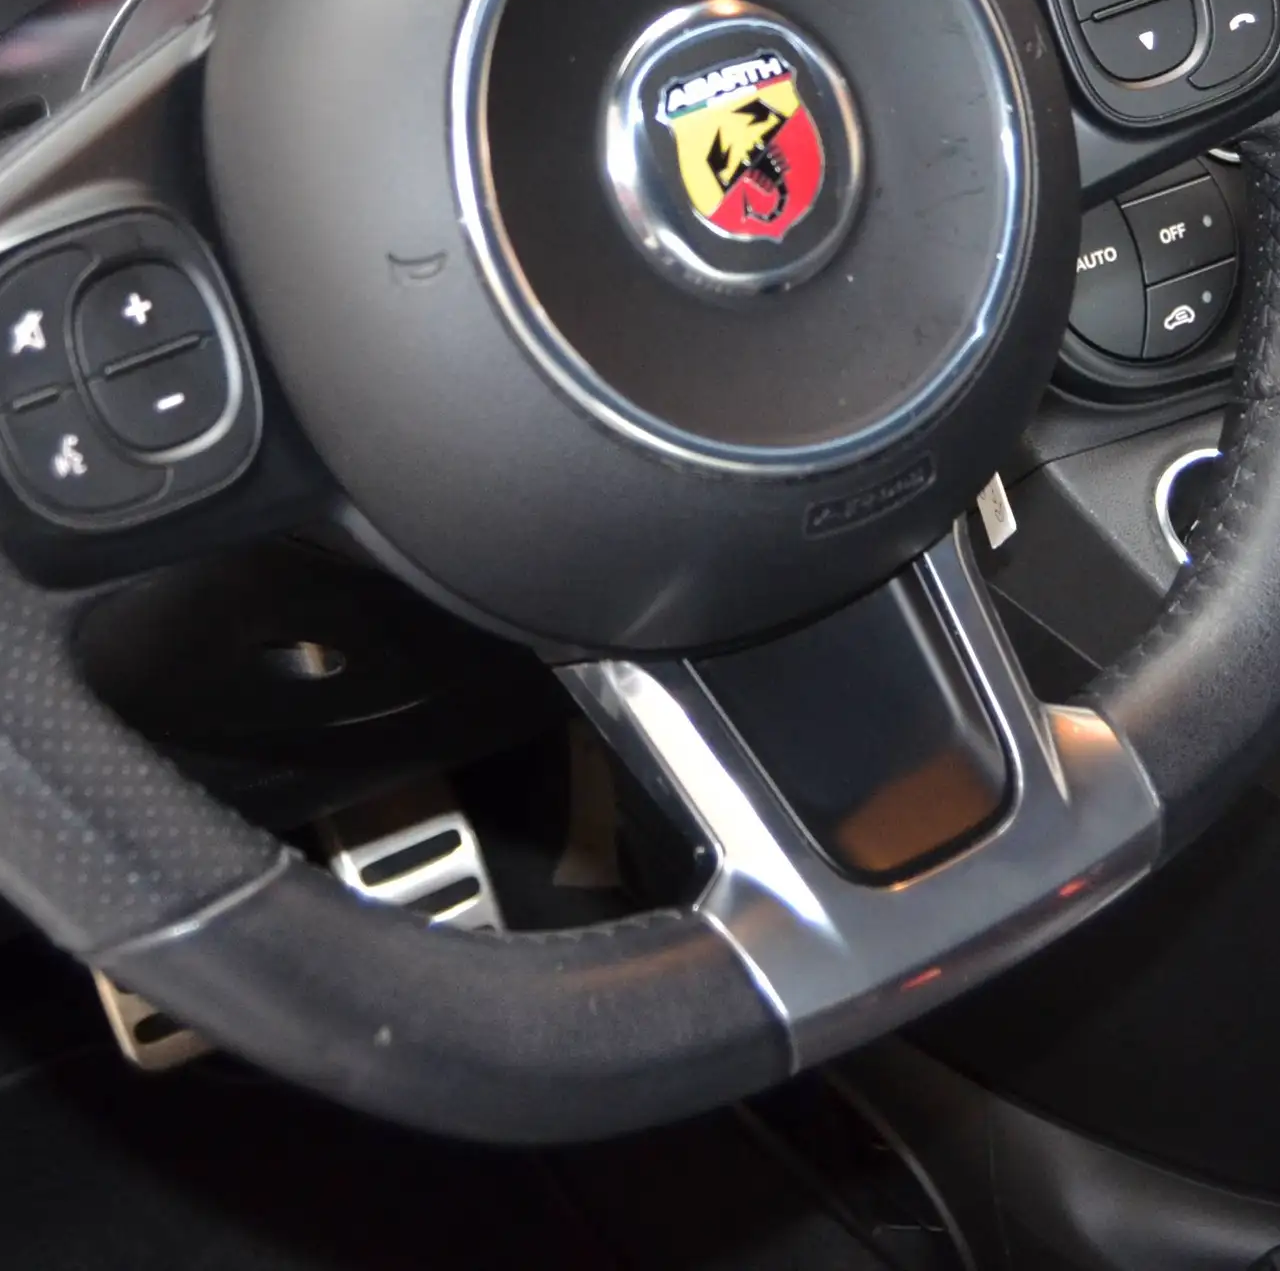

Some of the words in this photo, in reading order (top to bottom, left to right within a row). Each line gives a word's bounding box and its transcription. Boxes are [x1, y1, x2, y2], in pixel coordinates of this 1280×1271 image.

[667, 57, 783, 113] ABARTH
[1158, 222, 1187, 244] OFF
[1075, 246, 1118, 273] AUTO
